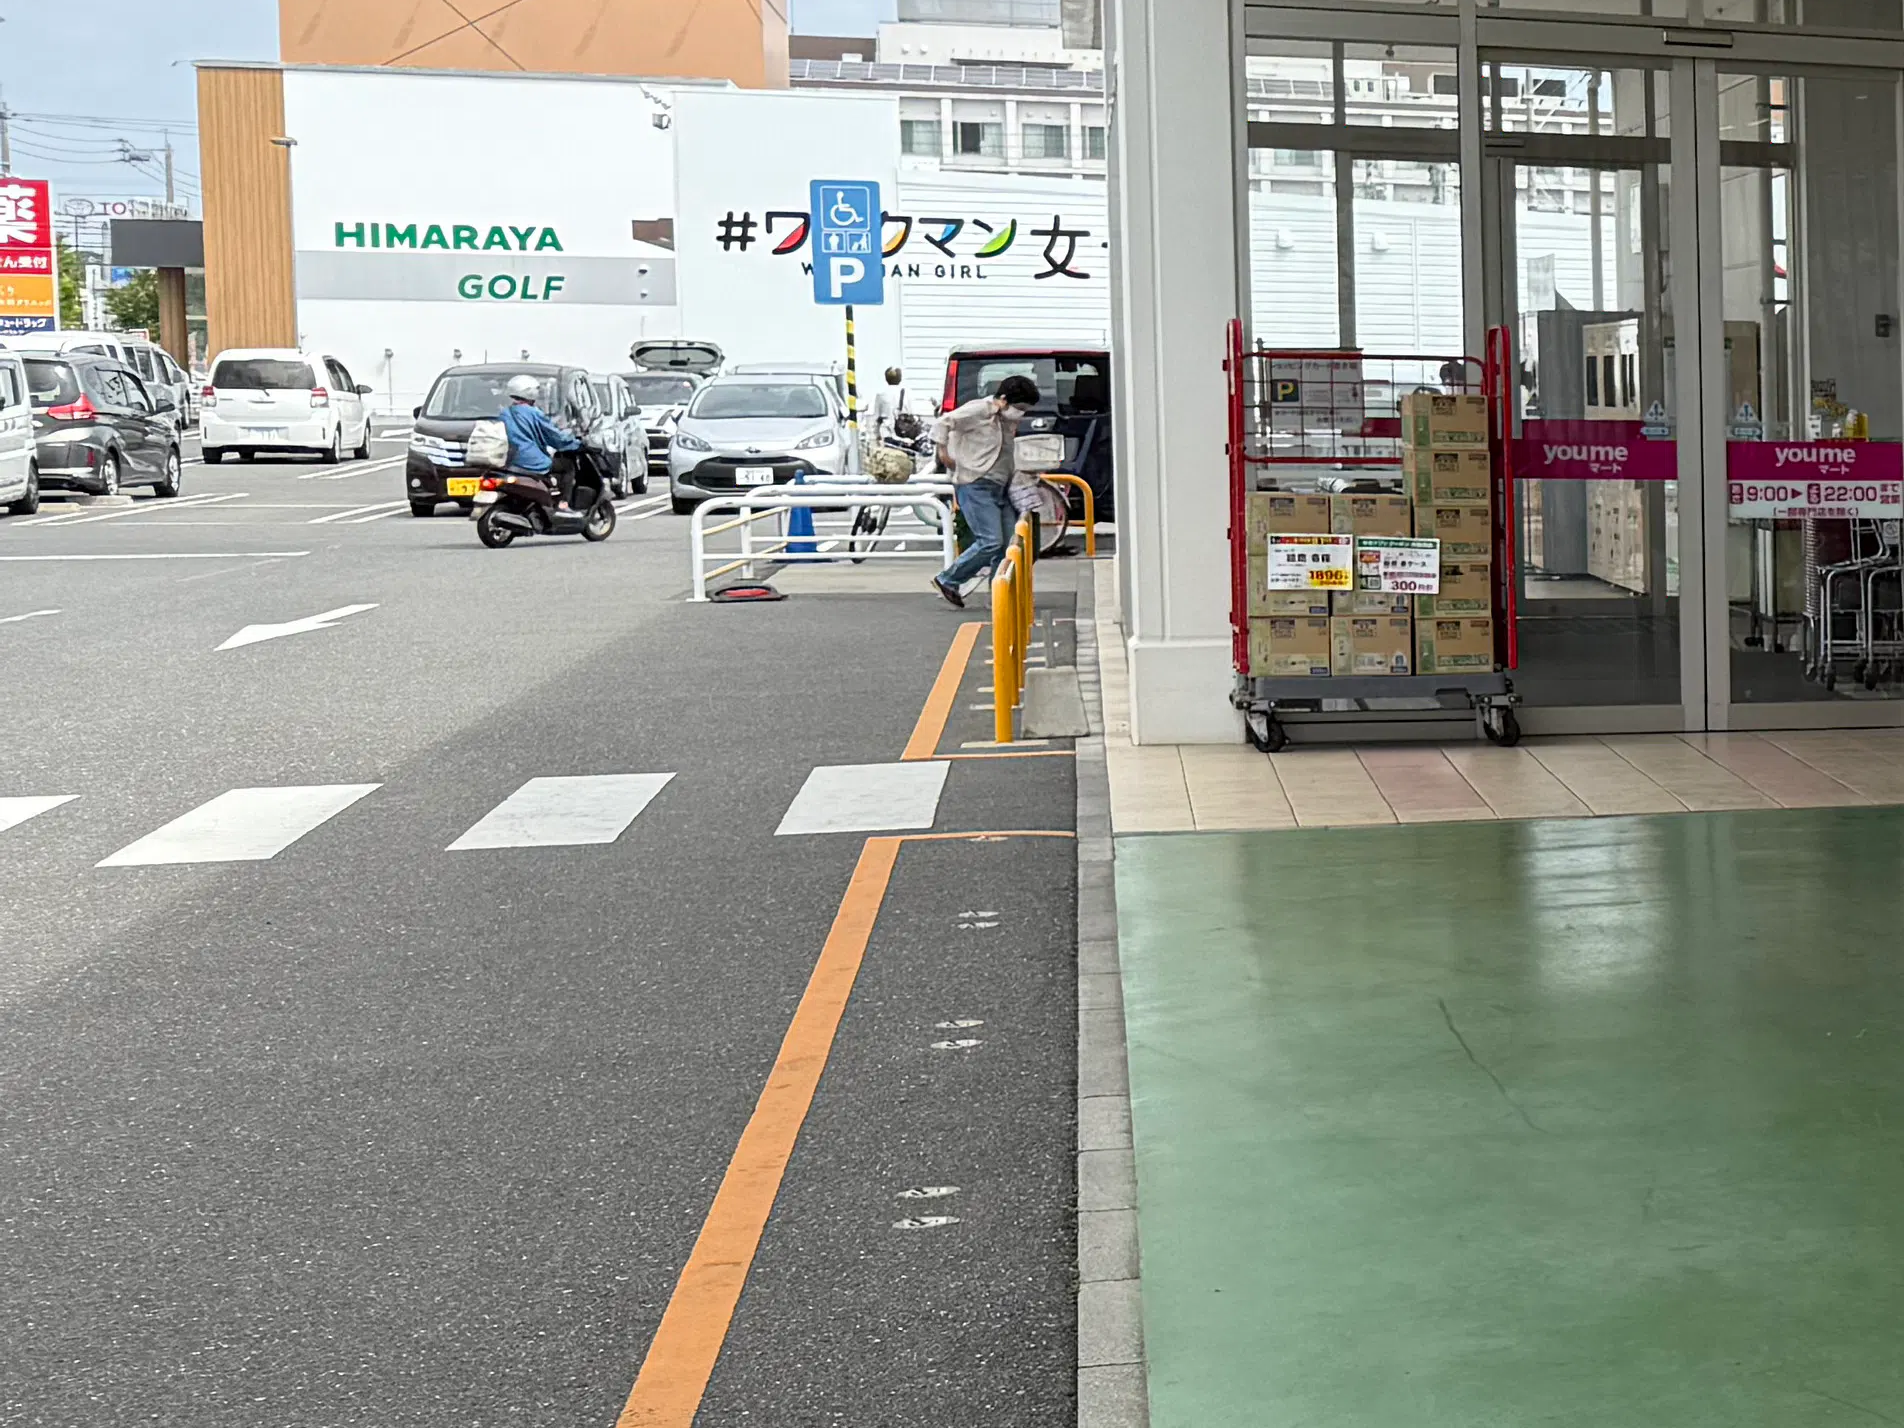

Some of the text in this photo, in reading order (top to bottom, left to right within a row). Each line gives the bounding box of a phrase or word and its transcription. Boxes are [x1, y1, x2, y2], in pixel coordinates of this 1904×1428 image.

[335, 222, 563, 251] HIMARAYA
[716, 211, 1108, 279] #ワクマン女
[830, 257, 865, 299] P
[935, 264, 987, 279] GIRL
[457, 274, 565, 301] GOLF
[1543, 444, 1628, 465] youme
[1775, 446, 1856, 468] youme
